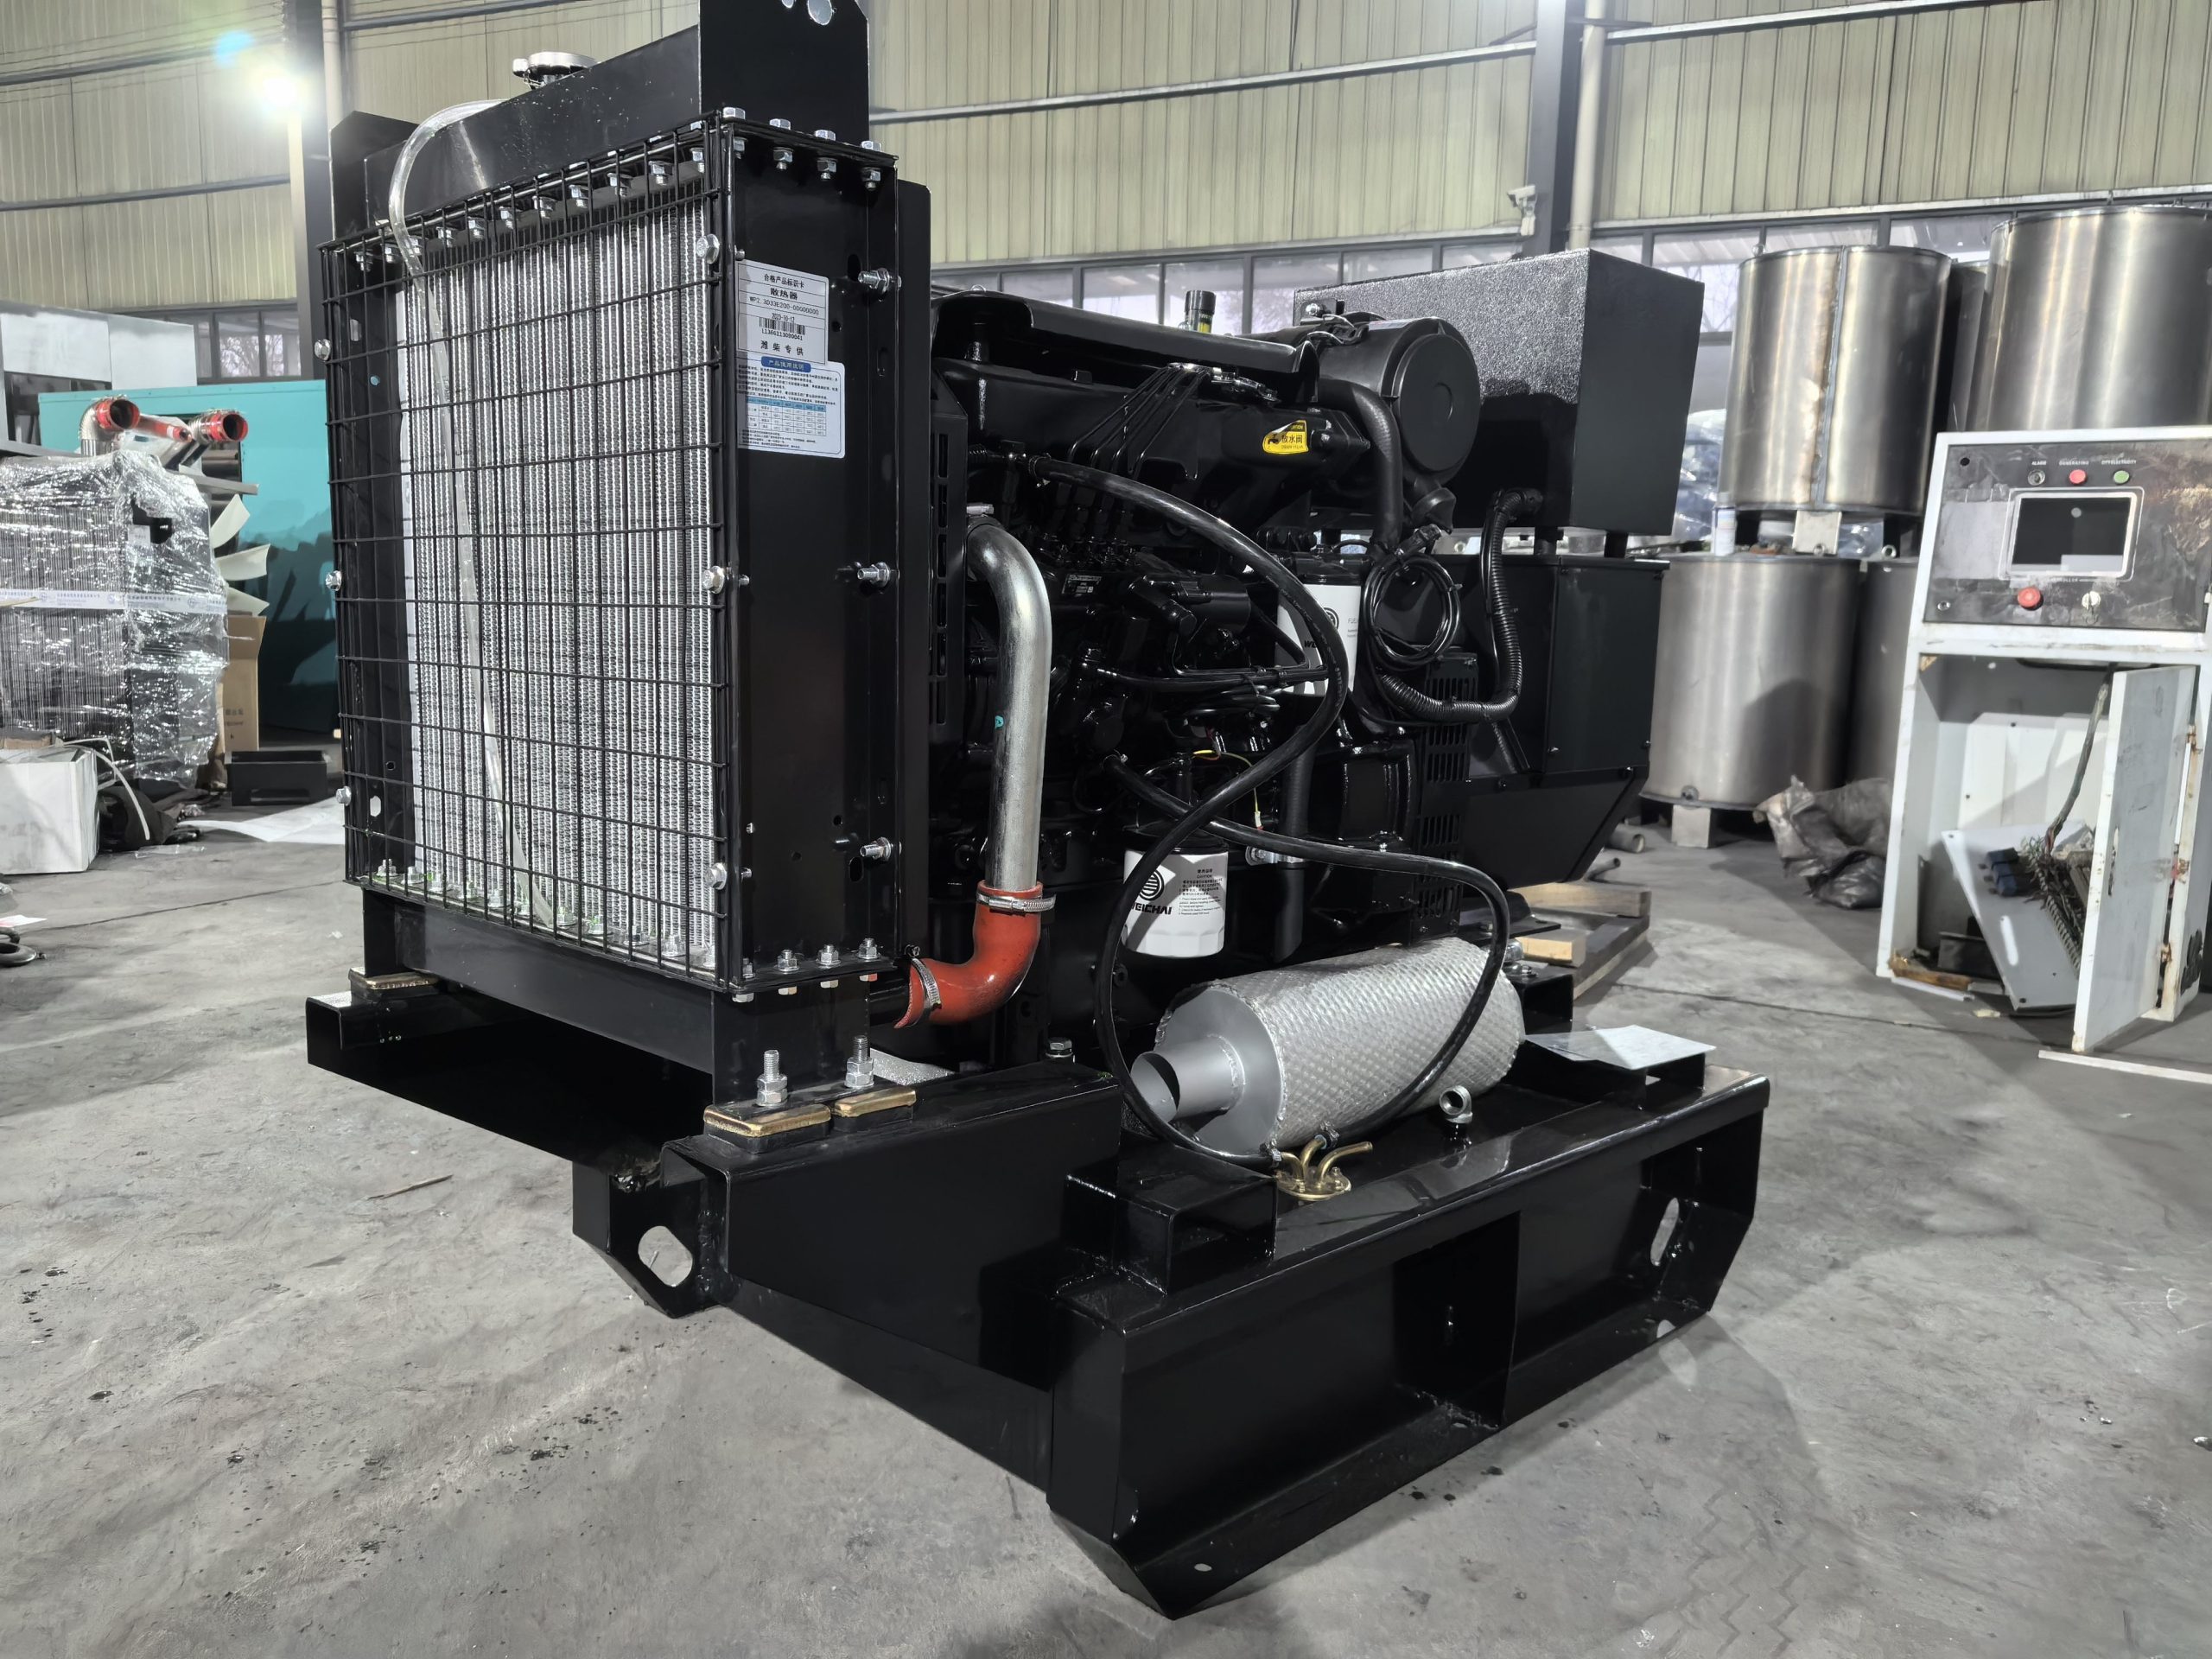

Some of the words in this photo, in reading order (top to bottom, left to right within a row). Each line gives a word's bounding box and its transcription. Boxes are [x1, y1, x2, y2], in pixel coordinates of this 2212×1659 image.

[764, 274, 804, 289] 合格产品标识卡
[770, 288, 798, 300] 散热器
